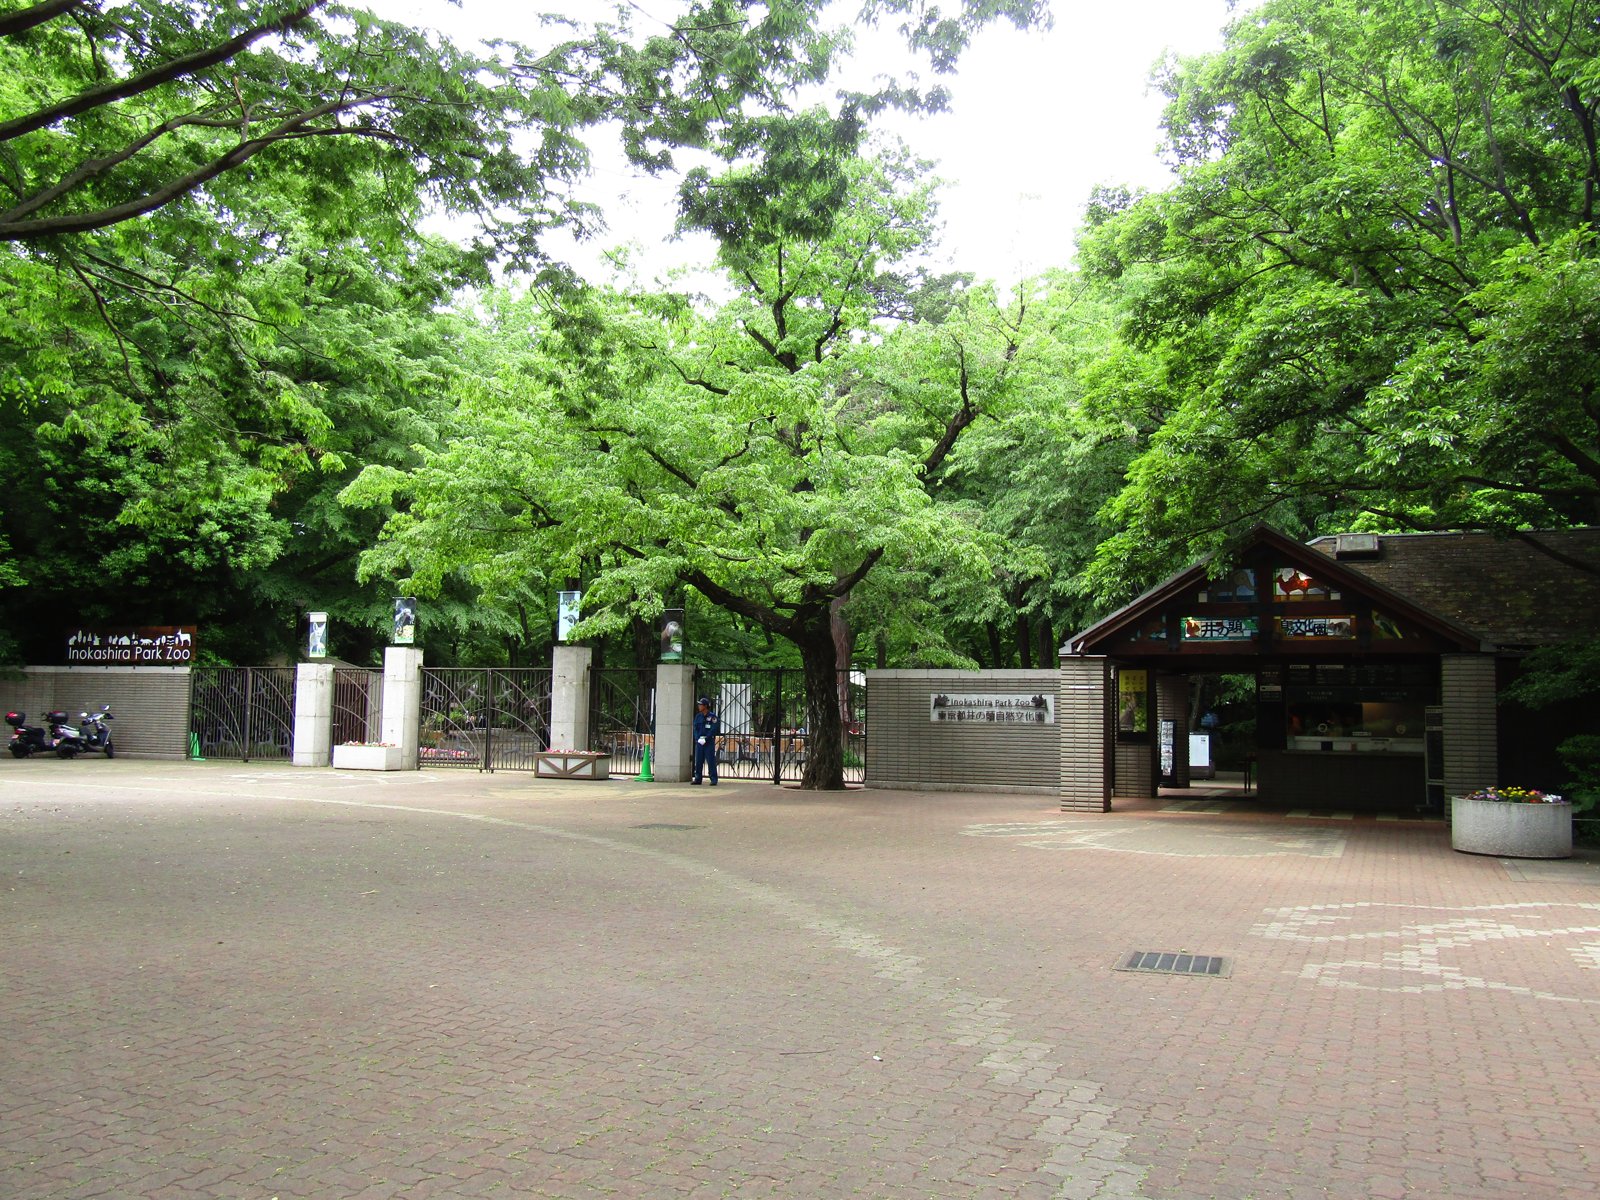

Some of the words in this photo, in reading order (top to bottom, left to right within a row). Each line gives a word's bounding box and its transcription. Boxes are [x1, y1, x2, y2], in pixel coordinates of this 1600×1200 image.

[1201, 619, 1243, 638] 井の頭
[69, 646, 130, 660] Inokashira
[135, 646, 162, 660] Park
[166, 646, 190, 660] Zoo
[951, 698, 993, 707] Inokashira
[995, 699, 1013, 708] Park
[1015, 699, 1030, 707] Zoo
